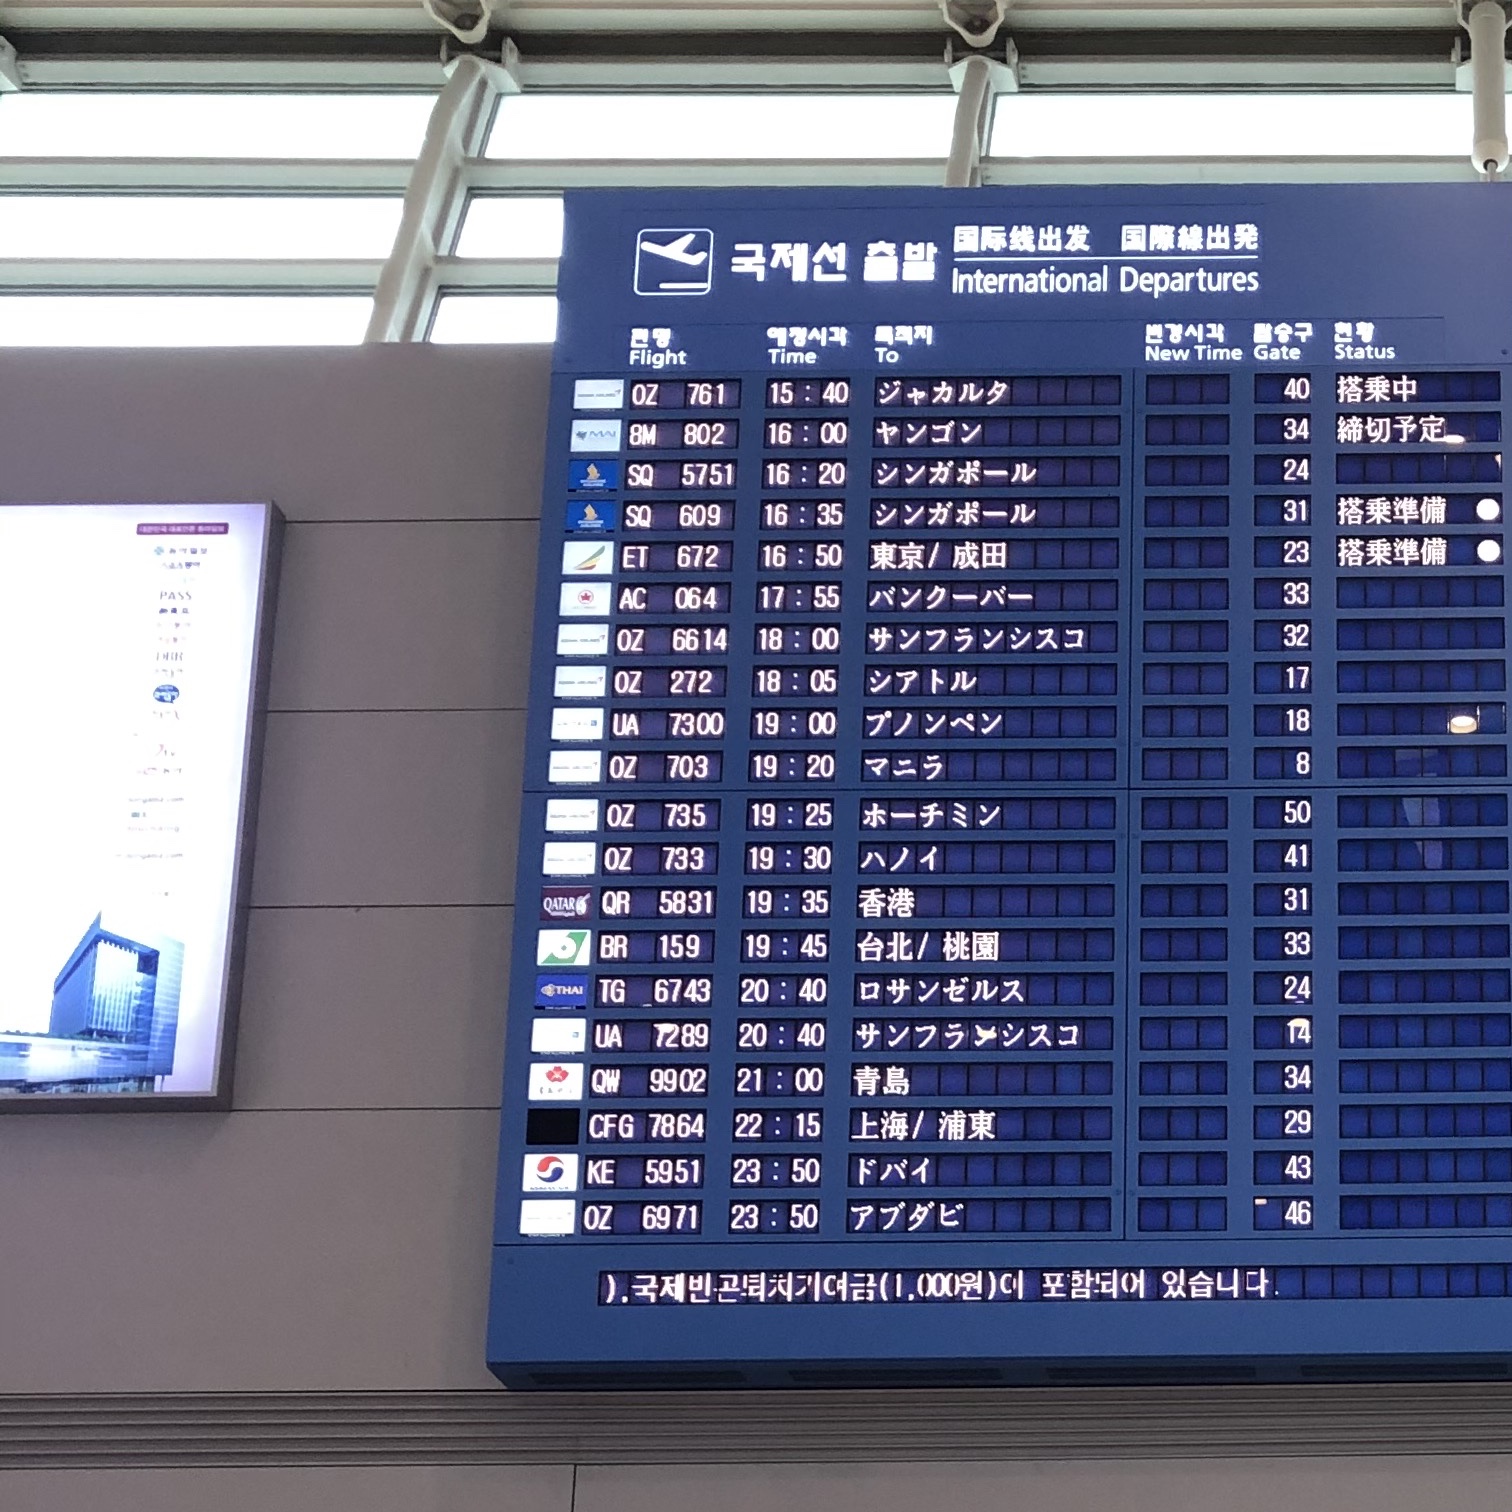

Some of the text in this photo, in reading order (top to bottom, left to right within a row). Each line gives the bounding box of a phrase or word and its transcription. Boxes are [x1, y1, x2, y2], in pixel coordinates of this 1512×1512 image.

[954, 226, 1090, 252] 国际线出发
[731, 241, 938, 282] 국제선 출발
[953, 265, 1258, 298] International Departures
[630, 348, 687, 369] Flight
[768, 348, 817, 364] Time
[875, 348, 899, 363] To
[1145, 345, 1243, 361] New Time
[1254, 345, 1301, 360] Gate
[1335, 344, 1396, 360] Status
[632, 384, 724, 405] OZ 761
[1284, 378, 1310, 399] 40
[630, 423, 725, 445] 8M 802
[1284, 418, 1309, 439] 34
[628, 464, 653, 487] SQ
[682, 464, 732, 485] 5751
[1284, 459, 1309, 480] 24
[626, 504, 721, 528] SQ 609
[1284, 500, 1306, 521] 31
[623, 546, 718, 568] ET 672
[1284, 541, 1309, 562] 23
[620, 587, 717, 609] AC 064
[1284, 583, 1309, 604] 33
[617, 629, 727, 651] OZ 6614
[1284, 624, 1309, 646] 32
[615, 671, 712, 693] OZ 272
[1287, 667, 1309, 688] 17
[613, 713, 723, 736] UA 7300
[1287, 709, 1309, 731] 18
[610, 755, 708, 778] OZ 703
[1297, 752, 1309, 774] 8
[607, 804, 706, 827] OZ 735
[1284, 801, 1310, 823] 50
[605, 847, 704, 870] OZ 733
[1285, 844, 1307, 866] 41
[543, 897, 575, 912] QATAR
[602, 891, 711, 915] QR 5831
[1285, 888, 1307, 910] 31
[601, 935, 700, 958] BR 159
[1285, 932, 1310, 954] 33
[555, 985, 583, 995] THAI
[599, 979, 710, 1003] TG 6743
[1285, 976, 1311, 998] 24
[595, 1023, 708, 1048] UA 7289
[592, 1069, 706, 1094] QW 9902
[1285, 1065, 1311, 1088] 34
[589, 1114, 704, 1138] CFG 7864
[1285, 1110, 1311, 1133] 29
[588, 1160, 699, 1184] KE 5951
[1285, 1156, 1311, 1179] 43
[584, 1205, 696, 1230] OZ 6971
[1285, 1200, 1311, 1224] 46
